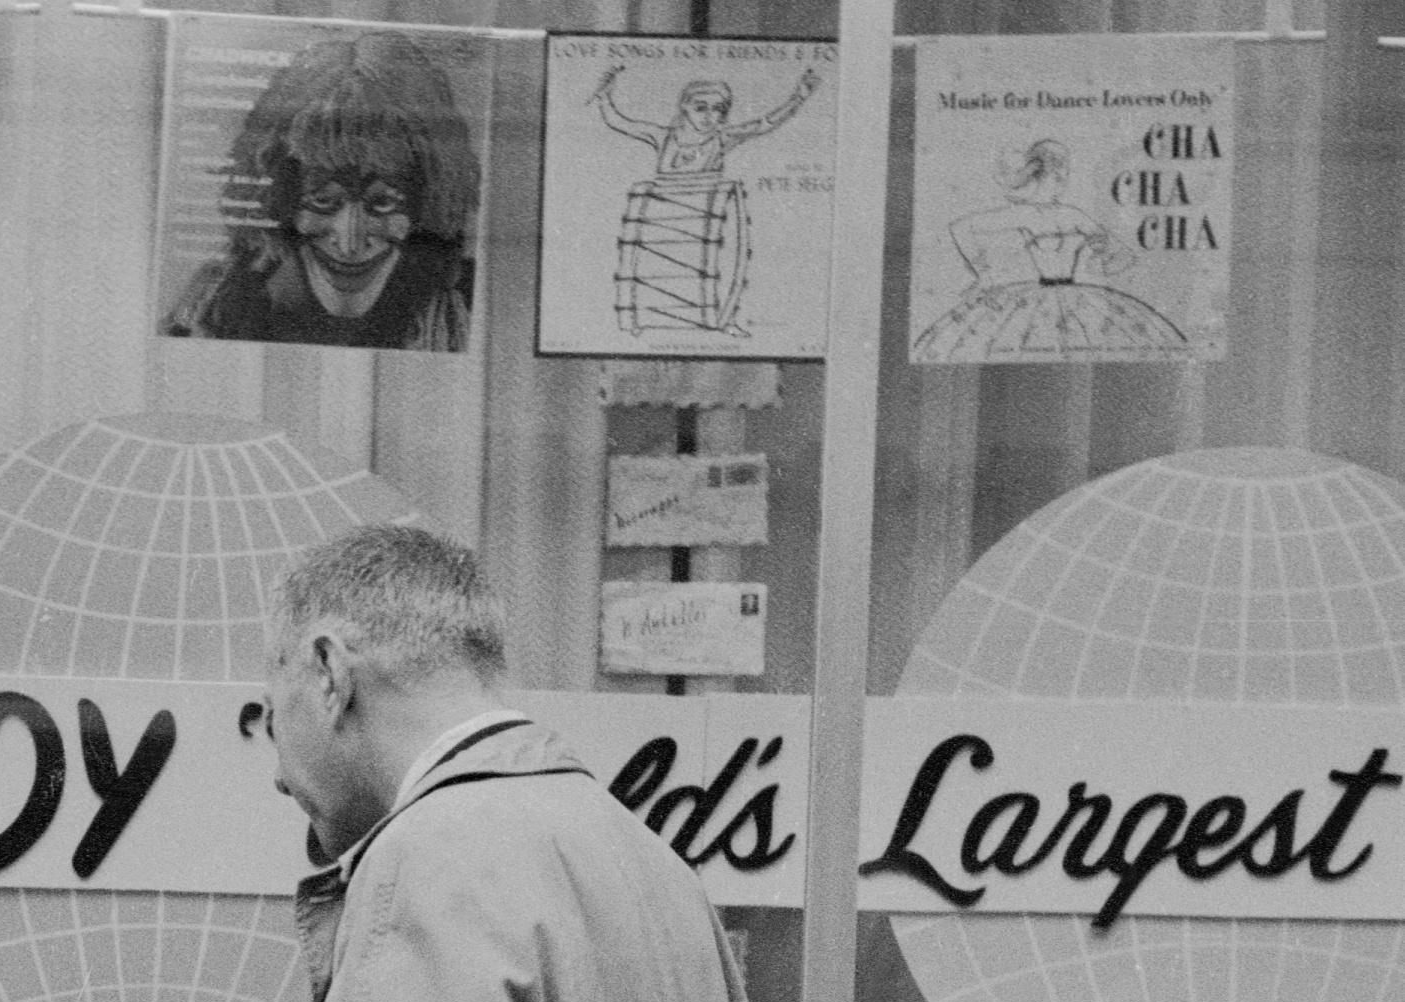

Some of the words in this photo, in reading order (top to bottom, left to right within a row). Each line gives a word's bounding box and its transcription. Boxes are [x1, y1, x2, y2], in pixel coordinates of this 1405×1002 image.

[552, 42, 597, 60] LOVE
[605, 43, 665, 60] SONGS
[671, 43, 708, 60] FOR
[715, 44, 787, 61] FRIENDS
[811, 44, 838, 62] FO
[936, 91, 996, 111] Music
[1002, 91, 1029, 109] for
[1034, 90, 1095, 110] Dance
[1101, 89, 1166, 109] Lovers
[1169, 88, 1213, 114] Only
[1140, 122, 1222, 160] CHA
[798, 175, 836, 193] SEEG
[1108, 169, 1191, 207] CHA
[1134, 214, 1220, 251] CHA
[858, 733, 1403, 930] Largest
